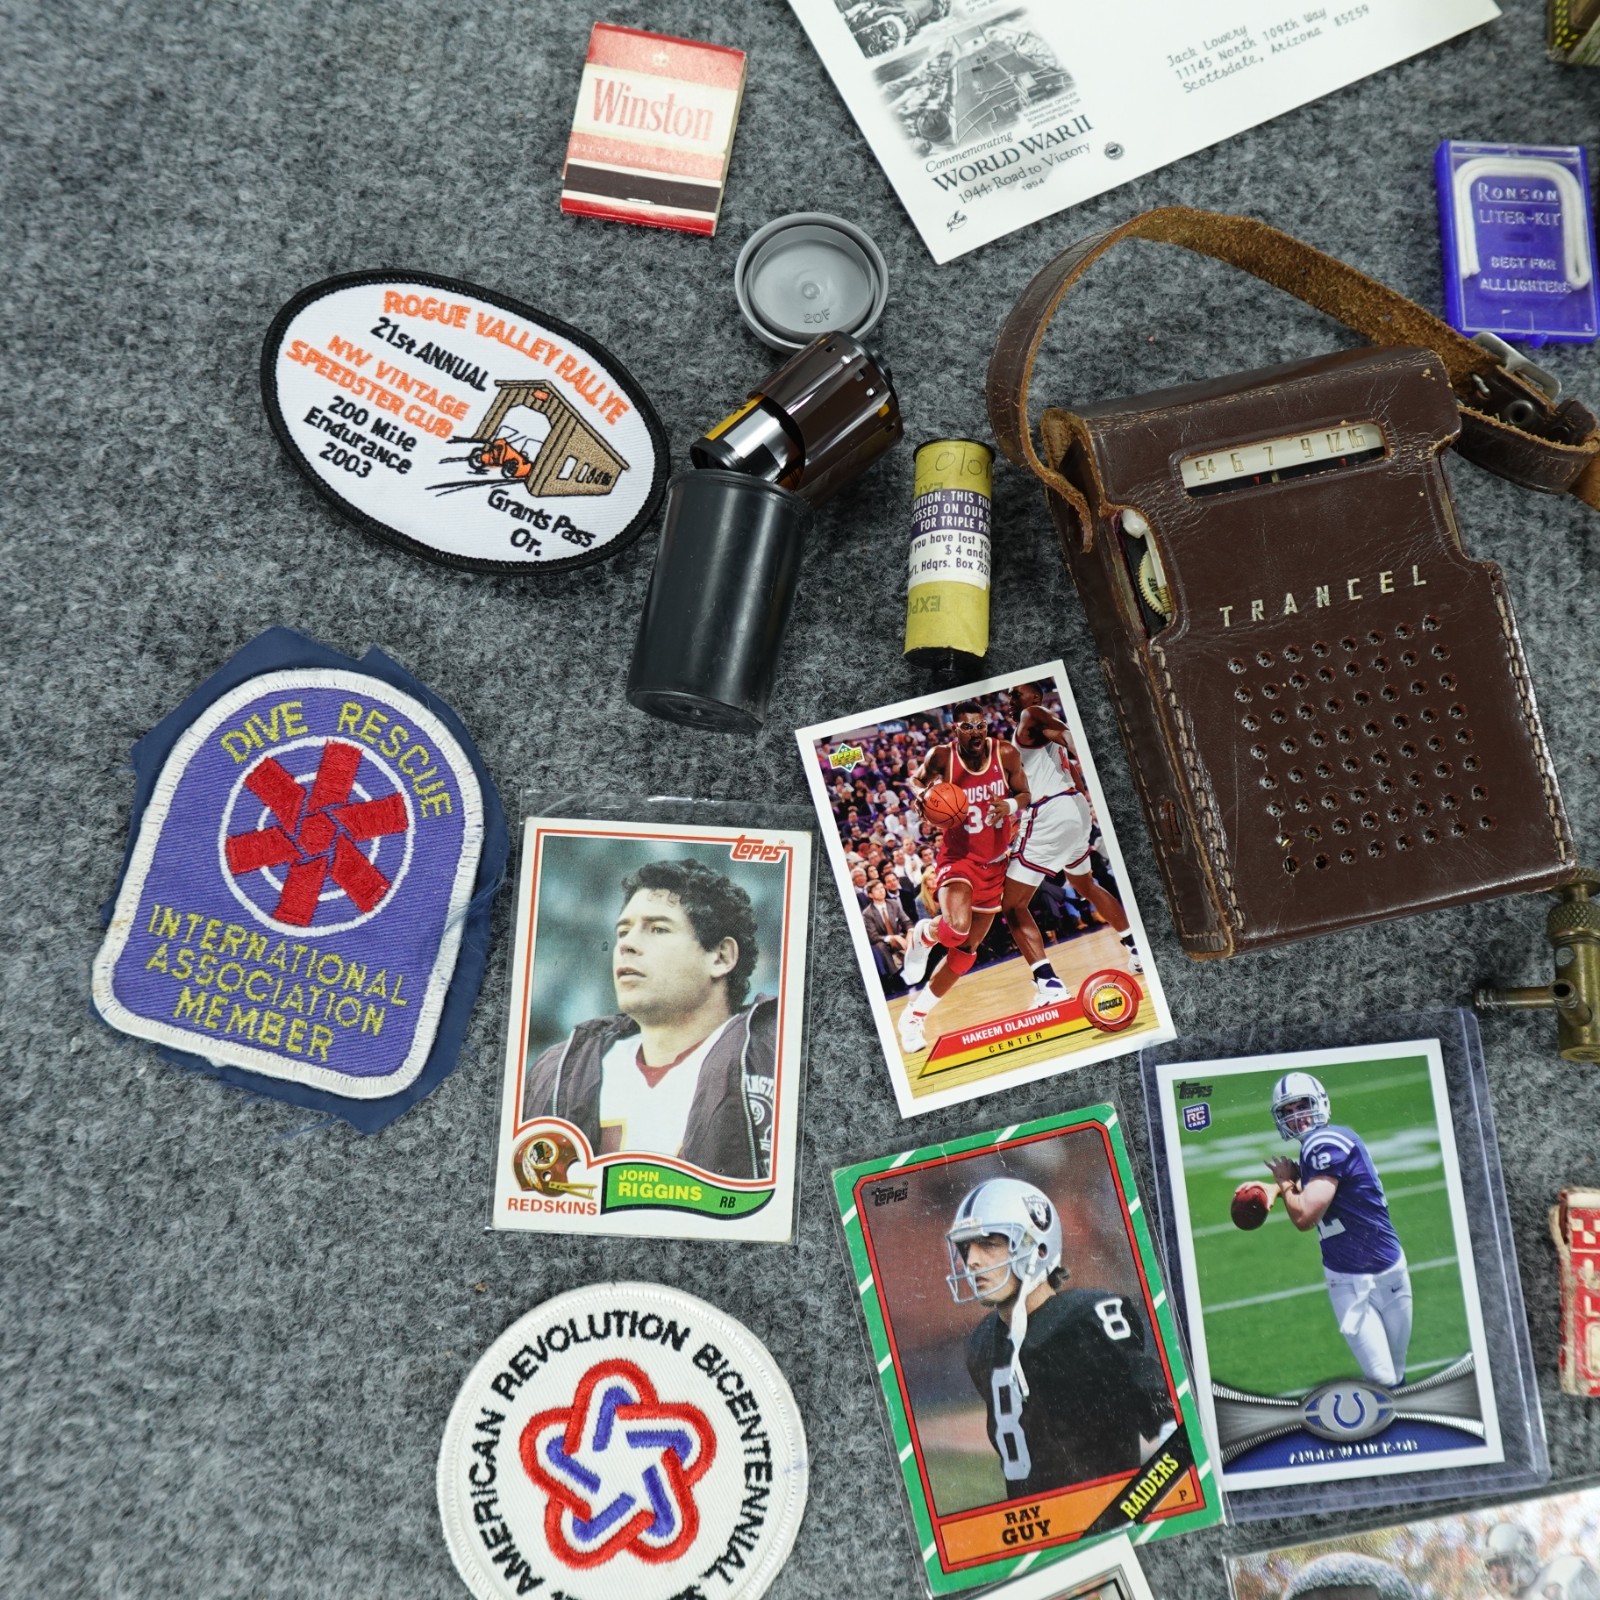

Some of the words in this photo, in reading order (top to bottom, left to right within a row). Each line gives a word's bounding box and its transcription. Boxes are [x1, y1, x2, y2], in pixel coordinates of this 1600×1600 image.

[1166, 47, 1198, 68] Jack
[1203, 25, 1248, 51] Lowery
[1176, 56, 1213, 80] 11145
[1218, 36, 1258, 62] North
[1263, 17, 1300, 42] 109th
[1303, 7, 1328, 24] Way
[1183, 52, 1265, 94] Scottsdale,
[1270, 26, 1323, 54] Arizona
[1334, 4, 1370, 28] 85259
[593, 78, 715, 141] Winston
[573, 142, 622, 159] FILTER
[925, 130, 1014, 174] Commemorating
[932, 148, 1021, 192] WORLD
[1018, 125, 1076, 155] WAR
[1072, 114, 1094, 135] II
[958, 181, 993, 204] 1944:
[993, 169, 1027, 190] Road
[1028, 164, 1042, 176] to
[1041, 141, 1092, 167] Victory
[1021, 178, 1045, 192] 1994
[1478, 181, 1559, 202] RONSON
[1479, 209, 1561, 226] LITER-KIT
[1529, 257, 1558, 270] FOR
[1480, 278, 1506, 292] ALL
[1506, 278, 1573, 294] LIGHTERS
[369, 317, 416, 355] 21st
[414, 341, 489, 392] ANNUAL
[382, 290, 471, 330] ROGUE
[476, 311, 561, 367] VALLEY
[556, 357, 631, 427] RALLYE
[286, 339, 402, 414] SPEEDSTER
[403, 404, 455, 440] CLUB
[327, 335, 374, 368] NW
[377, 360, 471, 420] VINTAGE
[304, 406, 414, 475] Endurance
[327, 395, 369, 427] 200
[369, 414, 419, 453] Mile
[319, 442, 373, 480] 2003
[1230, 452, 1245, 473] 6
[1263, 446, 1274, 466] 7
[1300, 437, 1314, 458] 9
[943, 503, 959, 514] ON
[964, 505, 984, 519] OUR
[950, 490, 975, 504] THIS
[487, 490, 552, 532] Grants
[551, 514, 597, 549] Pass
[920, 517, 937, 533] FOR
[941, 515, 975, 529] TRIPLE
[930, 534, 954, 544] have
[959, 532, 976, 545] lost
[510, 529, 542, 557] Or.
[955, 544, 963, 555] 4
[966, 547, 984, 559] and
[921, 558, 951, 572] Hdqrs.
[956, 557, 974, 570] Box
[1219, 564, 1427, 628] TRANCEL
[219, 700, 309, 765] DIVE
[336, 701, 455, 819] RESCUE
[147, 903, 409, 1007] INTERNATIONAL
[145, 943, 386, 1037] ASSOCIATION
[173, 985, 337, 1062] MEMBER
[962, 1024, 1003, 1046] HAKEEM
[1004, 1009, 1060, 1033] OLAJUWON
[988, 1031, 1044, 1053] CENTER
[1186, 1110, 1206, 1123] RC
[618, 1169, 660, 1182] JOHN
[1311, 1151, 1332, 1171] 12
[508, 1197, 598, 1216] REDSKINS
[617, 1182, 703, 1202] RIGGINS
[719, 1195, 737, 1209] RB
[1094, 1297, 1132, 1341] 8
[490, 1309, 692, 1402] REVOLUTION
[990, 1366, 1032, 1481] 8
[692, 1343, 774, 1586] BICENTENNIAL
[469, 1407, 546, 1596] AMERICAN
[1119, 1452, 1180, 1521] RAIDERS
[1179, 1489, 1188, 1502] P
[1001, 1519, 1052, 1546] GUY
[1004, 1505, 1042, 1526] RAY
